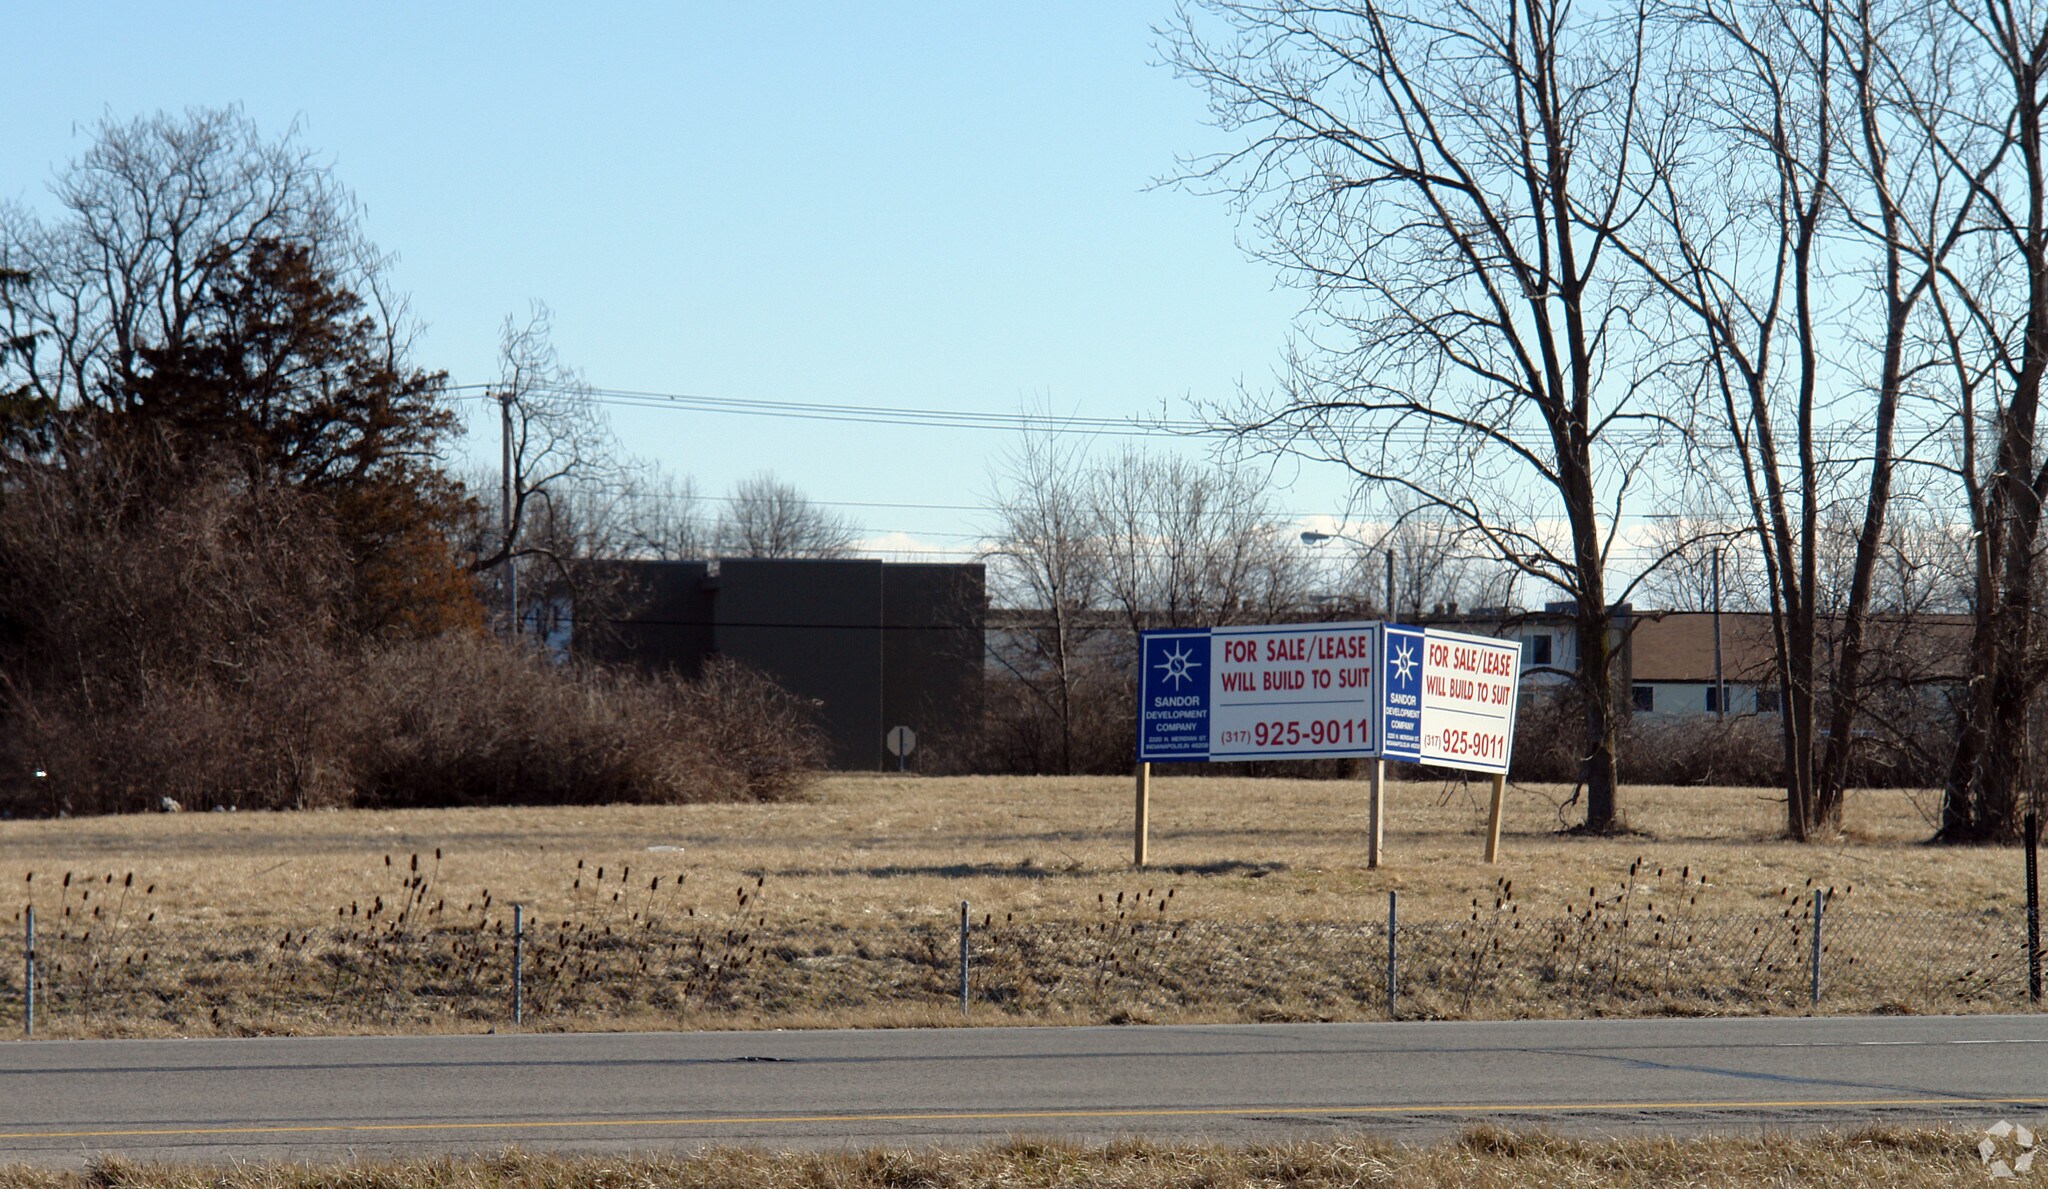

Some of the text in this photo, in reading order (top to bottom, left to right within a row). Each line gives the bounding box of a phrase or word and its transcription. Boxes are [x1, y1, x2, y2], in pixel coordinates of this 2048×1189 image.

[1225, 635, 1366, 663] FOR SALE/LEASE
[1174, 659, 1182, 673] S
[1429, 643, 1511, 676] FOR SALE/LEASE
[1221, 668, 1370, 692] WILL BUILD TO SUIT
[1426, 675, 1510, 706] WILL BUILD TO SUIT
[1154, 696, 1200, 707] SANDOR
[1390, 693, 1416, 706] SANDOR
[1146, 710, 1207, 719] DEVELOPMENT
[1386, 706, 1420, 719] DEVELOPMENT
[1156, 723, 1197, 732] COMPANY
[1391, 720, 1415, 731] COMPANY
[1221, 730, 1251, 746] (317)
[1254, 719, 1368, 747] 925-9011
[1424, 734, 1441, 750] (317)
[1442, 728, 1504, 759] 925-9011
